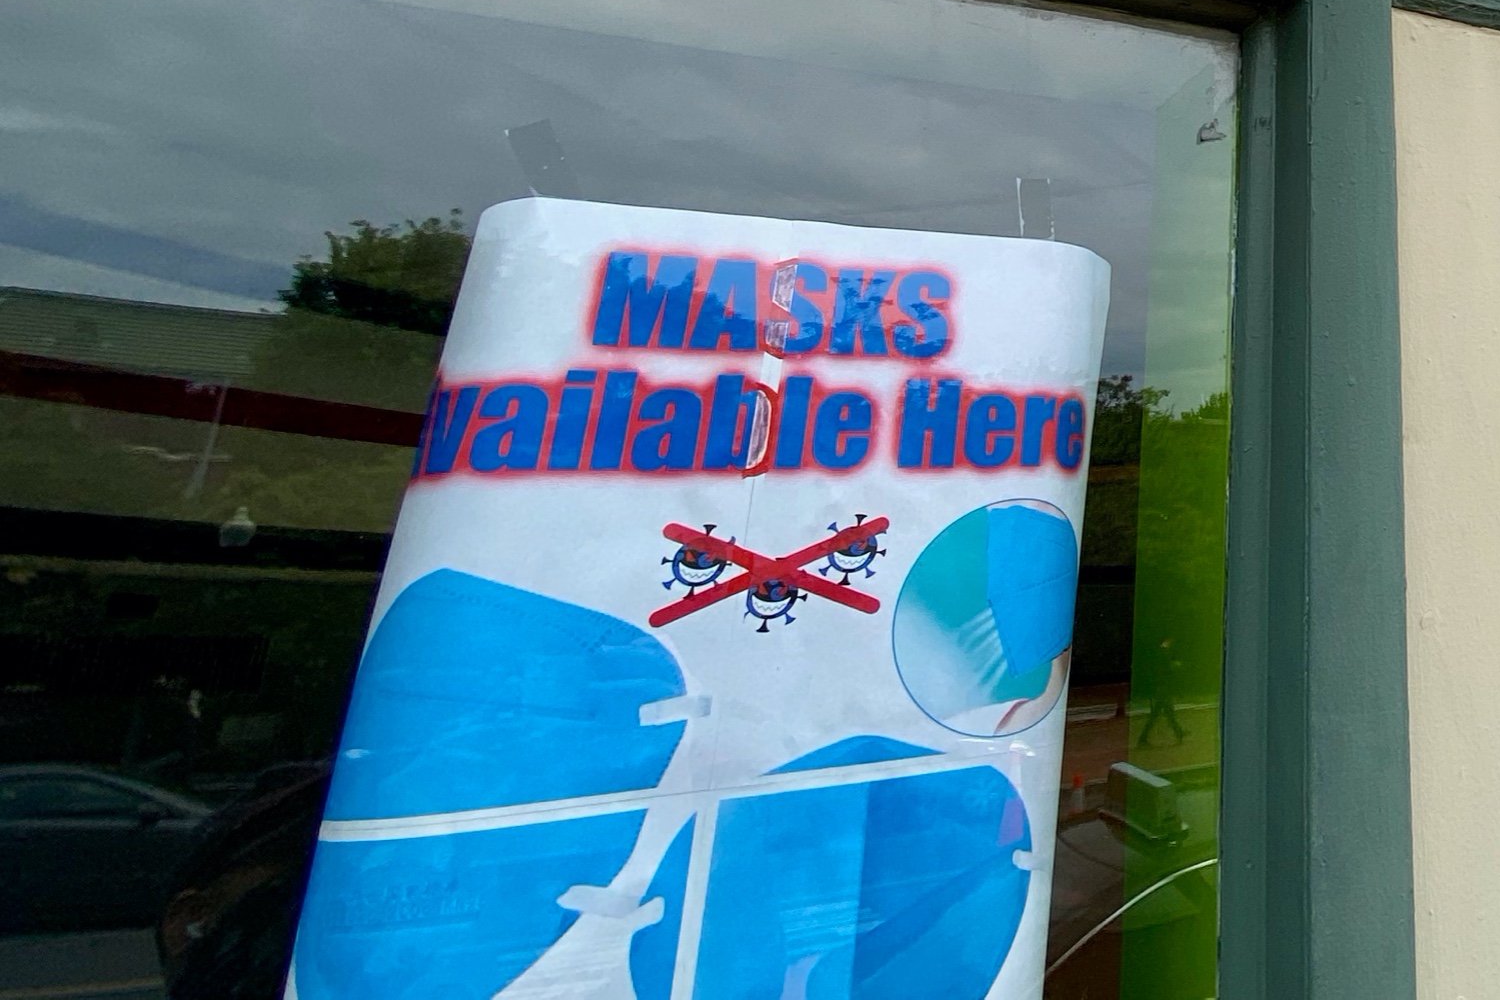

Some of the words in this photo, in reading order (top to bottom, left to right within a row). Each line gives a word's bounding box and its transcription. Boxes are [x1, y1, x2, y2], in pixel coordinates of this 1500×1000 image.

[592, 251, 951, 358] MASKS
[411, 370, 872, 475] vailable
[898, 378, 1084, 470] Here
